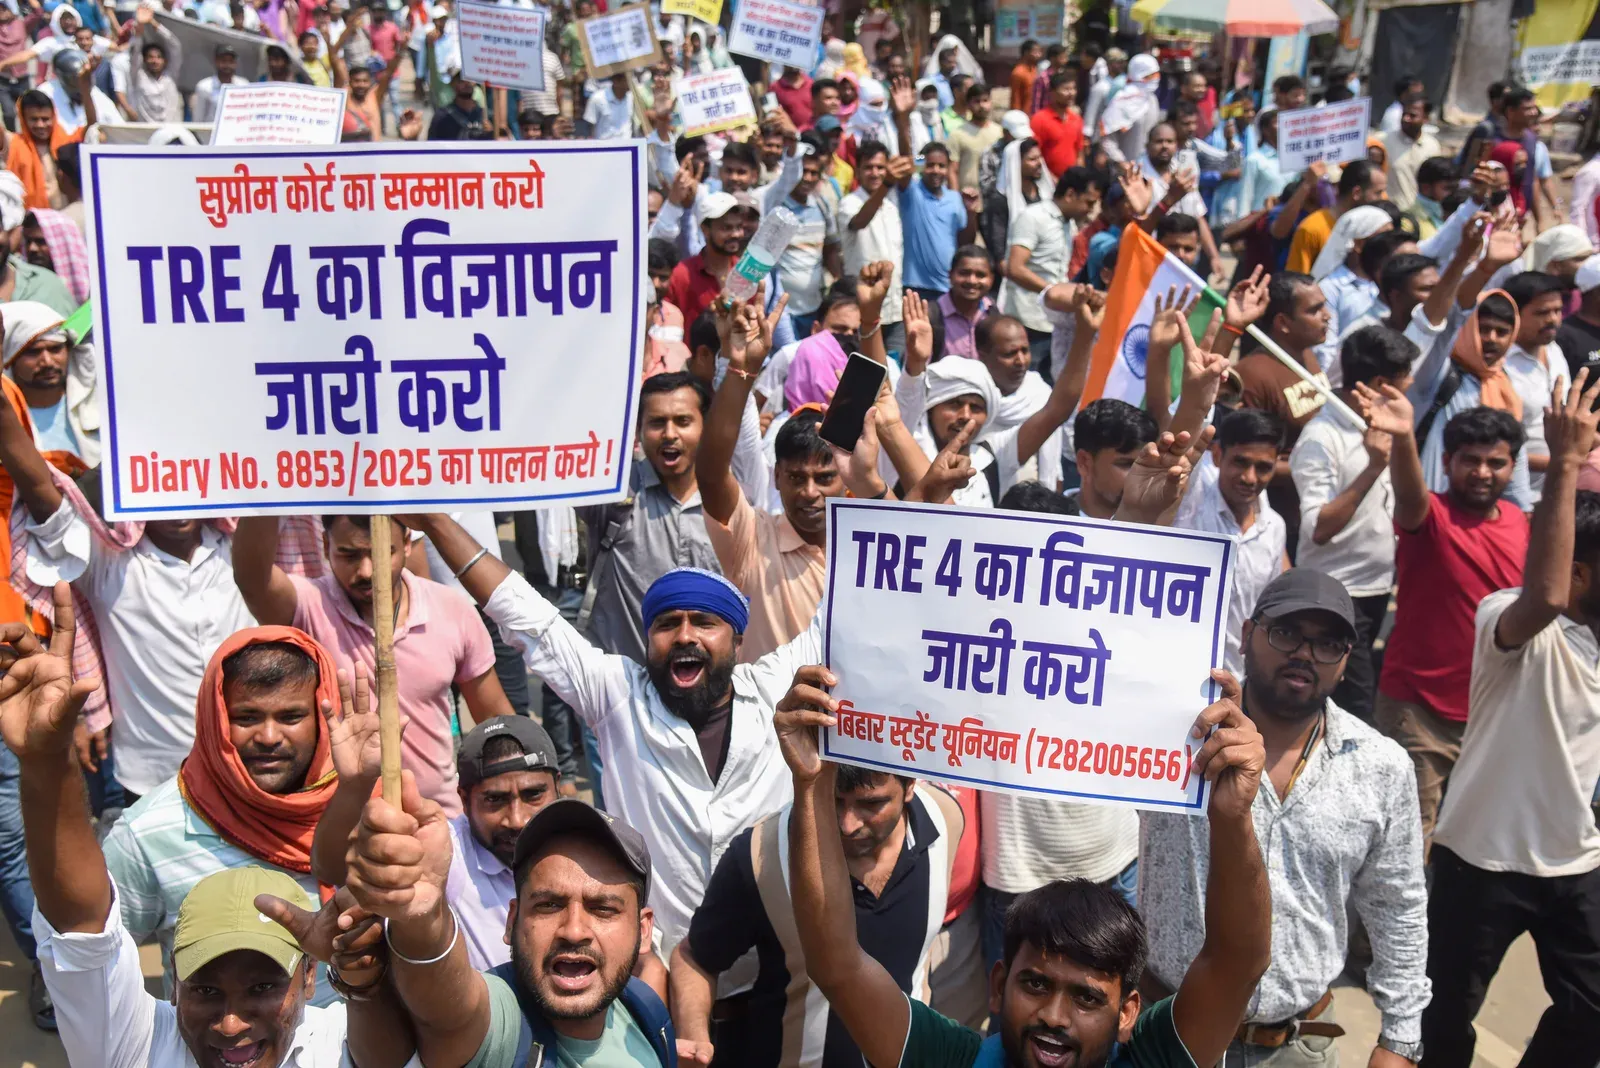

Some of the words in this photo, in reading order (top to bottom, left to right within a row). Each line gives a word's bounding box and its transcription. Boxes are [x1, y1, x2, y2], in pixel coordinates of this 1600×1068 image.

[196, 163, 279, 229] सुप्रीम
[283, 161, 336, 213] कोर्ट
[341, 173, 376, 211] का
[381, 172, 486, 211] सम्मान
[490, 159, 545, 209] करो
[127, 245, 245, 324] TRE
[262, 244, 300, 322] 4
[309, 244, 386, 321] का
[394, 217, 618, 319] विज्ञापन
[255, 335, 382, 435] जारी
[390, 333, 506, 433] करो
[130, 452, 210, 499] Diary
[219, 453, 268, 490] No.
[277, 442, 432, 496] 8853/2025
[438, 448, 474, 485] का
[478, 445, 550, 484] पालन
[555, 431, 600, 480] करो
[852, 530, 927, 593] TRE
[935, 538, 962, 597] 4
[974, 542, 1034, 603] का
[1039, 530, 1211, 622] विज्ञापन
[921, 618, 1017, 696] जारी
[1022, 628, 1111, 706] करो
[484, 722, 505, 734] NIKE
[835, 699, 886, 743] बिहार
[888, 710, 939, 762] स्टूडेंट
[941, 717, 1021, 767] यूनियन
[1025, 728, 1192, 790] (7282005656)
